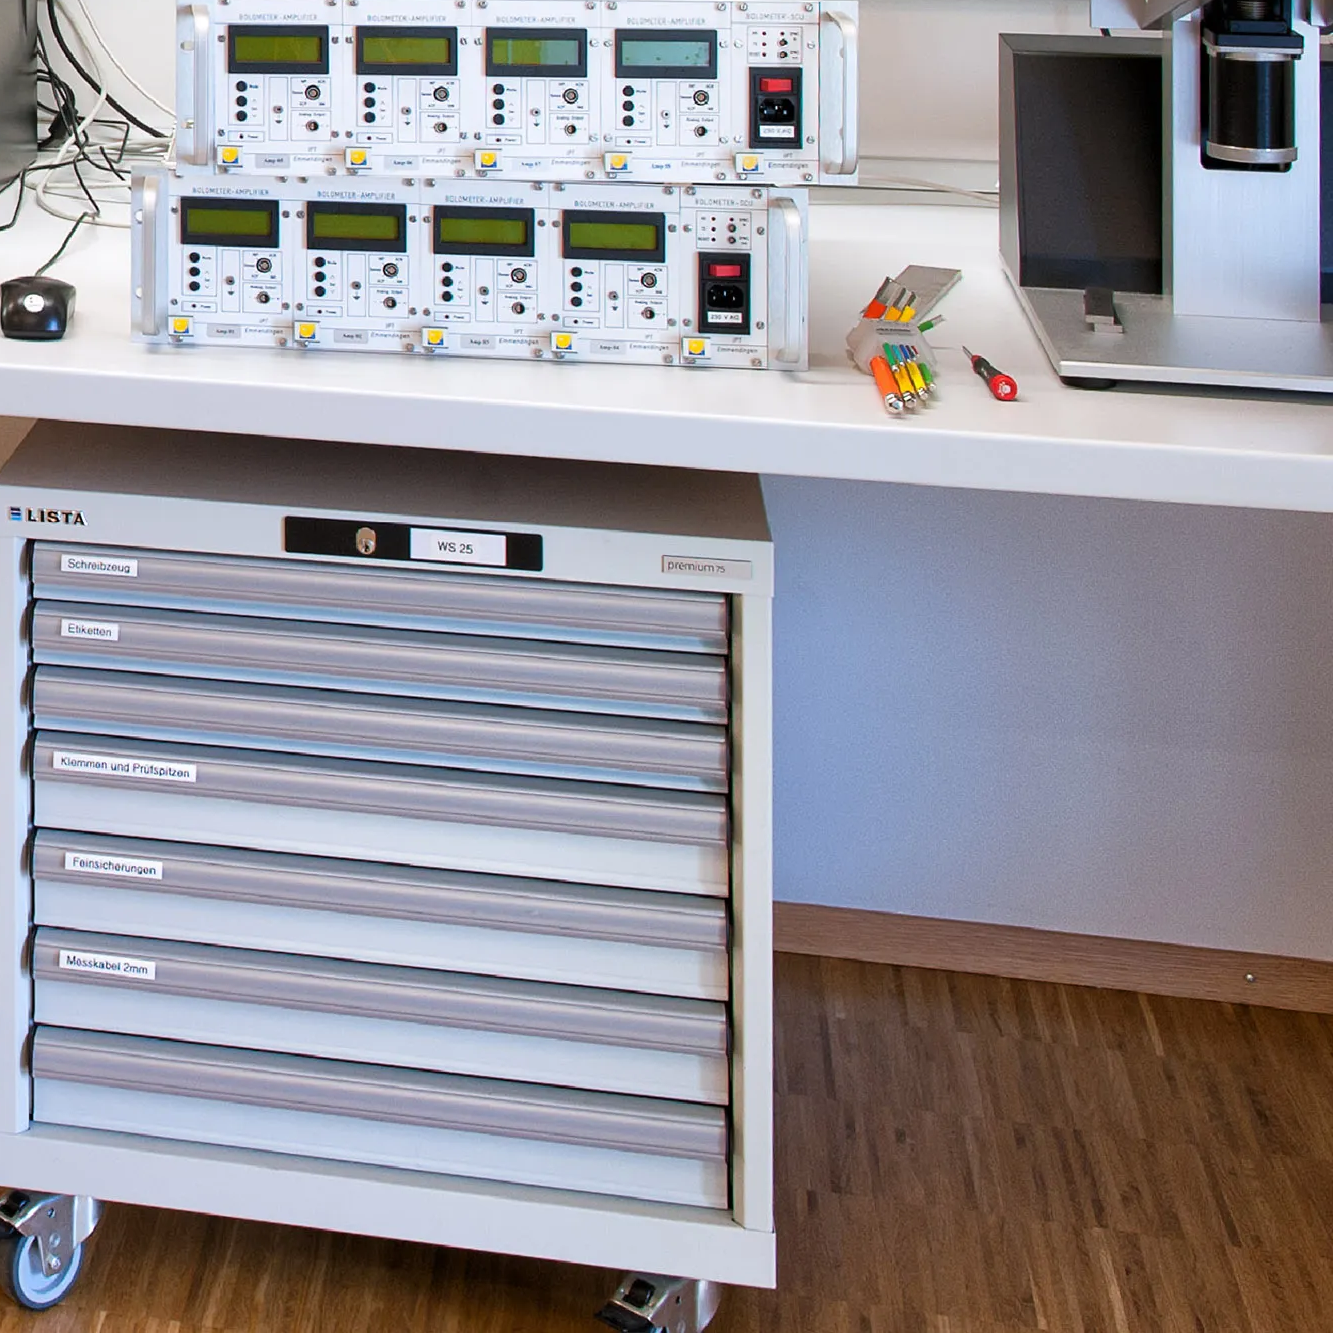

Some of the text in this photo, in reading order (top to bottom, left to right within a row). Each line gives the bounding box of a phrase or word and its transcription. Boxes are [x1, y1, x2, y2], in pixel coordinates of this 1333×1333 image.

[26, 507, 88, 526] LISTA
[437, 540, 474, 555] WS 25
[67, 558, 132, 574] Schreibzeug
[67, 623, 113, 638] Etiketten
[60, 756, 191, 778] Klemmen und Prüfspitzen
[72, 856, 157, 876] Feinsicherungen
[66, 955, 149, 975] Messkabel 2mm
